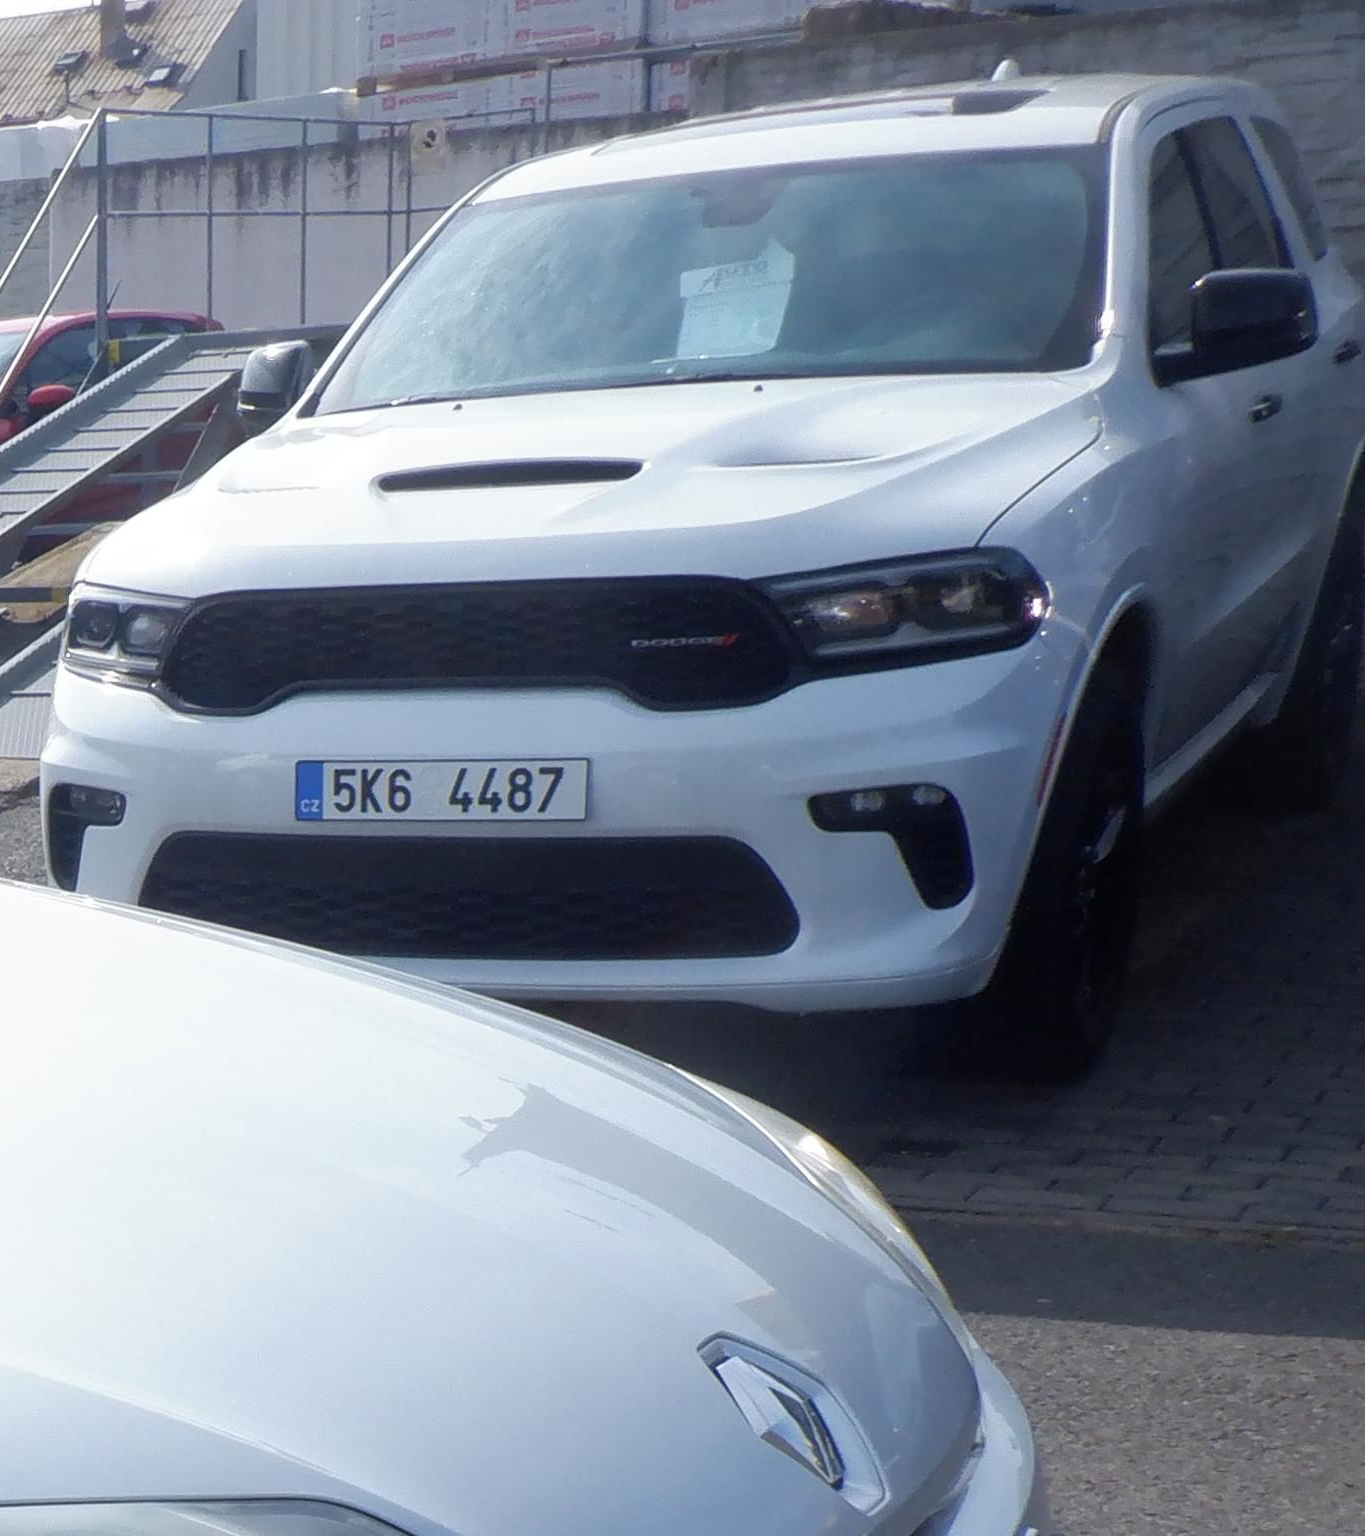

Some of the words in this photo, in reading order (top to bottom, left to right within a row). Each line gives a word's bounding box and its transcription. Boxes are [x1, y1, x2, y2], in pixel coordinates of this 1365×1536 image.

[300, 799, 320, 812] CZ
[332, 768, 413, 813] 5K6
[448, 767, 565, 813] 4487
